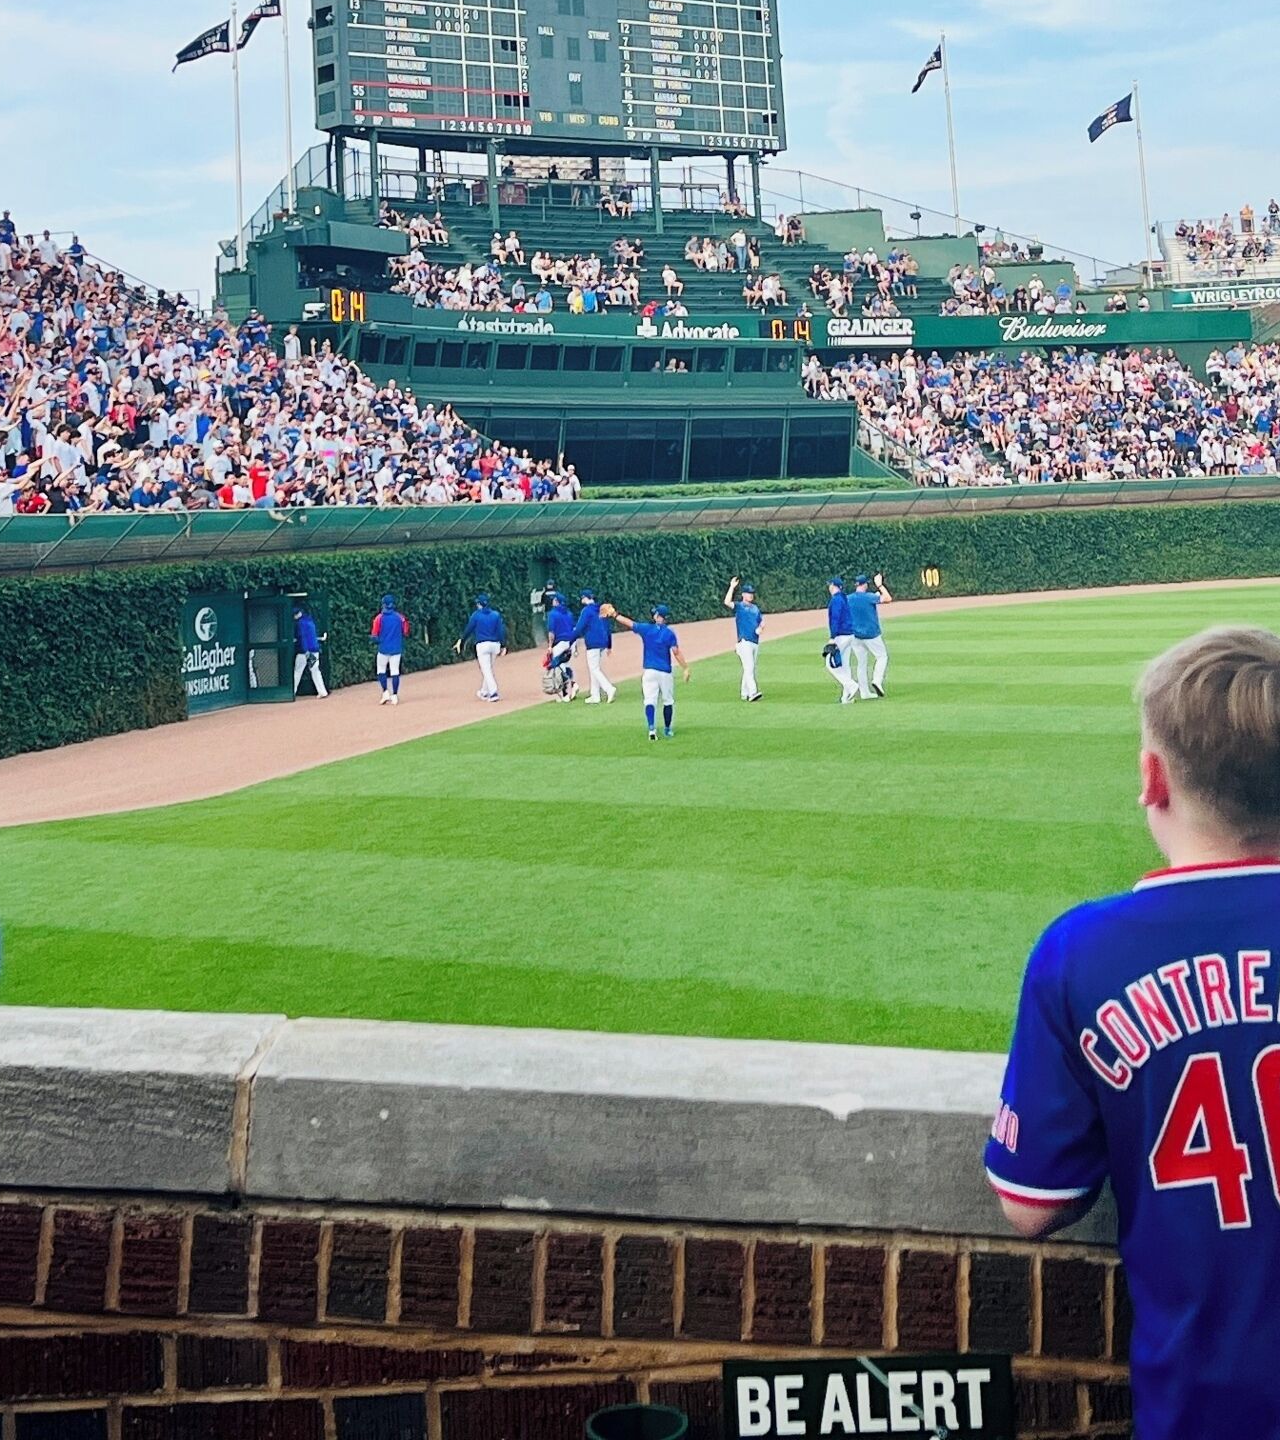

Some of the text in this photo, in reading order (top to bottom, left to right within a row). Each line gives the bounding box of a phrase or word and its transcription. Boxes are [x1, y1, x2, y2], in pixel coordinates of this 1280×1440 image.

[352, 13, 358, 23] 7
[464, 9, 469, 19] 2
[764, 12, 769, 21] 2
[537, 26, 554, 36] BALL
[620, 24, 629, 34] 12
[521, 42, 526, 51] 5
[623, 37, 628, 46] 7
[695, 57, 701, 66] 2
[625, 64, 630, 73] 2
[521, 70, 527, 79] 2
[569, 73, 581, 82] OUT
[522, 83, 528, 93] 3
[627, 104, 632, 113] 3
[599, 115, 618, 125] CUBS
[628, 117, 633, 127] 4
[441, 119, 445, 130] 1
[450, 121, 456, 131] 2
[460, 121, 466, 131] 3
[468, 122, 474, 132] 4
[478, 122, 484, 132] 5
[487, 123, 493, 133] 6
[496, 124, 503, 134] 7
[506, 124, 512, 134] 8
[515, 125, 521, 135] 9
[523, 125, 532, 135] 10
[709, 136, 715, 146] 2
[725, 138, 730, 147] 4
[733, 138, 738, 147] 5
[741, 138, 746, 148] 6
[749, 138, 754, 148] 7
[757, 139, 762, 148] 8
[765, 139, 770, 148] 9
[470, 317, 554, 335] tastytrade
[661, 321, 739, 339] Advocate
[772, 319, 811, 341] 0:14
[999, 317, 1106, 342] Budweiser
[736, 1368, 991, 1437] BE ALERT
